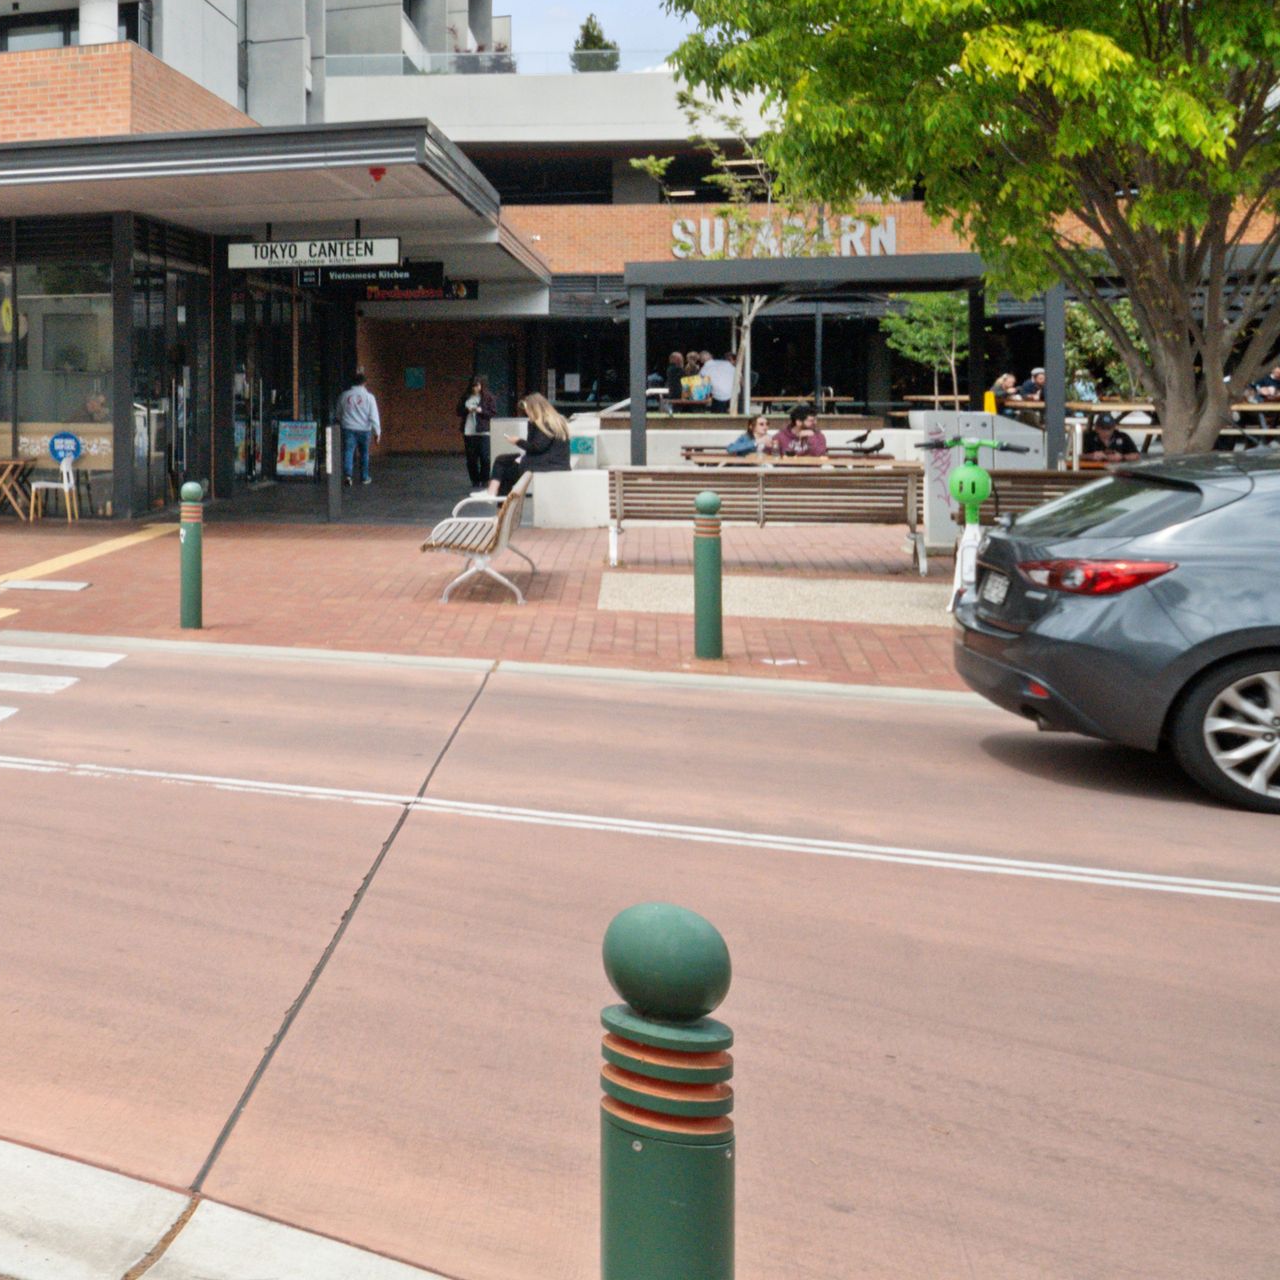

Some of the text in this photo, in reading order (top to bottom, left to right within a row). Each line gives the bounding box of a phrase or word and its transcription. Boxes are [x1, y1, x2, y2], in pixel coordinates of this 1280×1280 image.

[252, 241, 374, 260] TOKYO CANTEEN
[329, 271, 377, 280] Vietnamese
